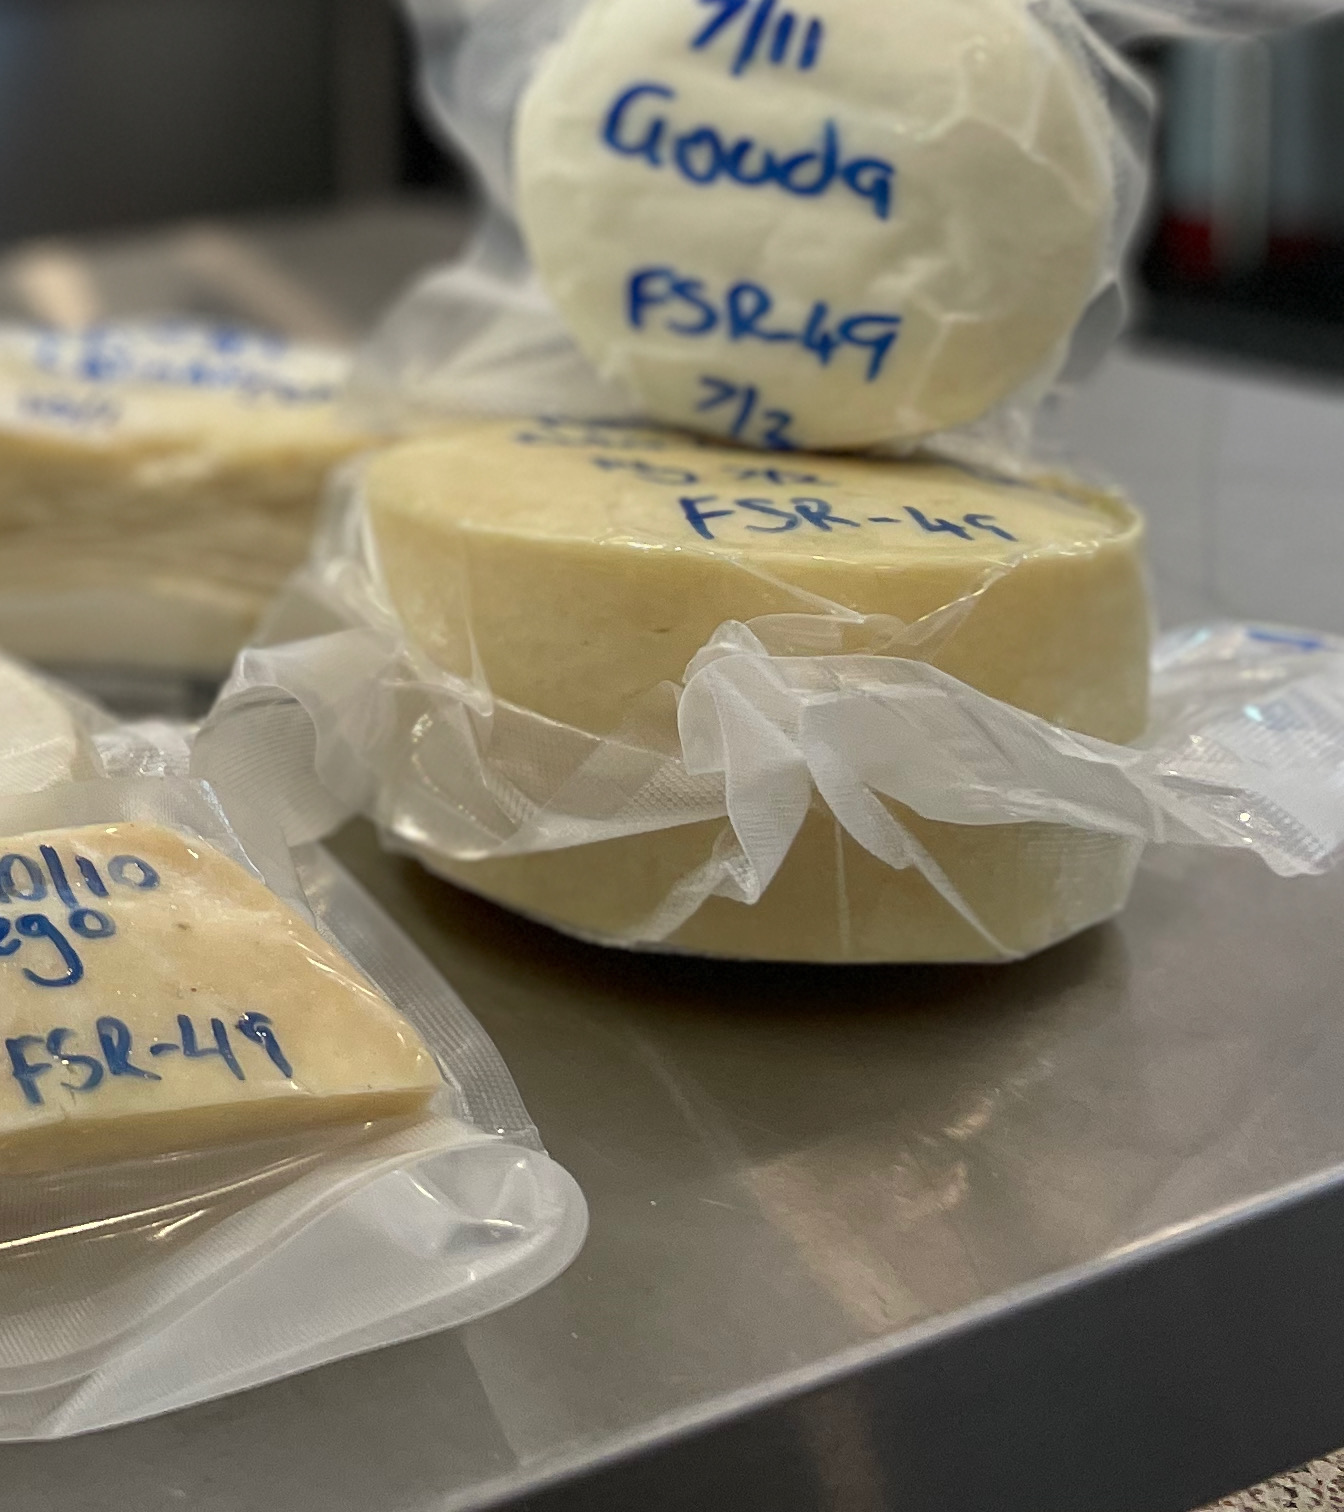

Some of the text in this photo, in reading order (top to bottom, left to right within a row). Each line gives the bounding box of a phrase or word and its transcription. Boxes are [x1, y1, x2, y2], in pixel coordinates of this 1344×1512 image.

[600, 82, 898, 220] Gouda
[624, 264, 904, 382] FSR-49
[676, 494, 1020, 544] FSR-49
[2, 1008, 296, 1105] FSR-49
